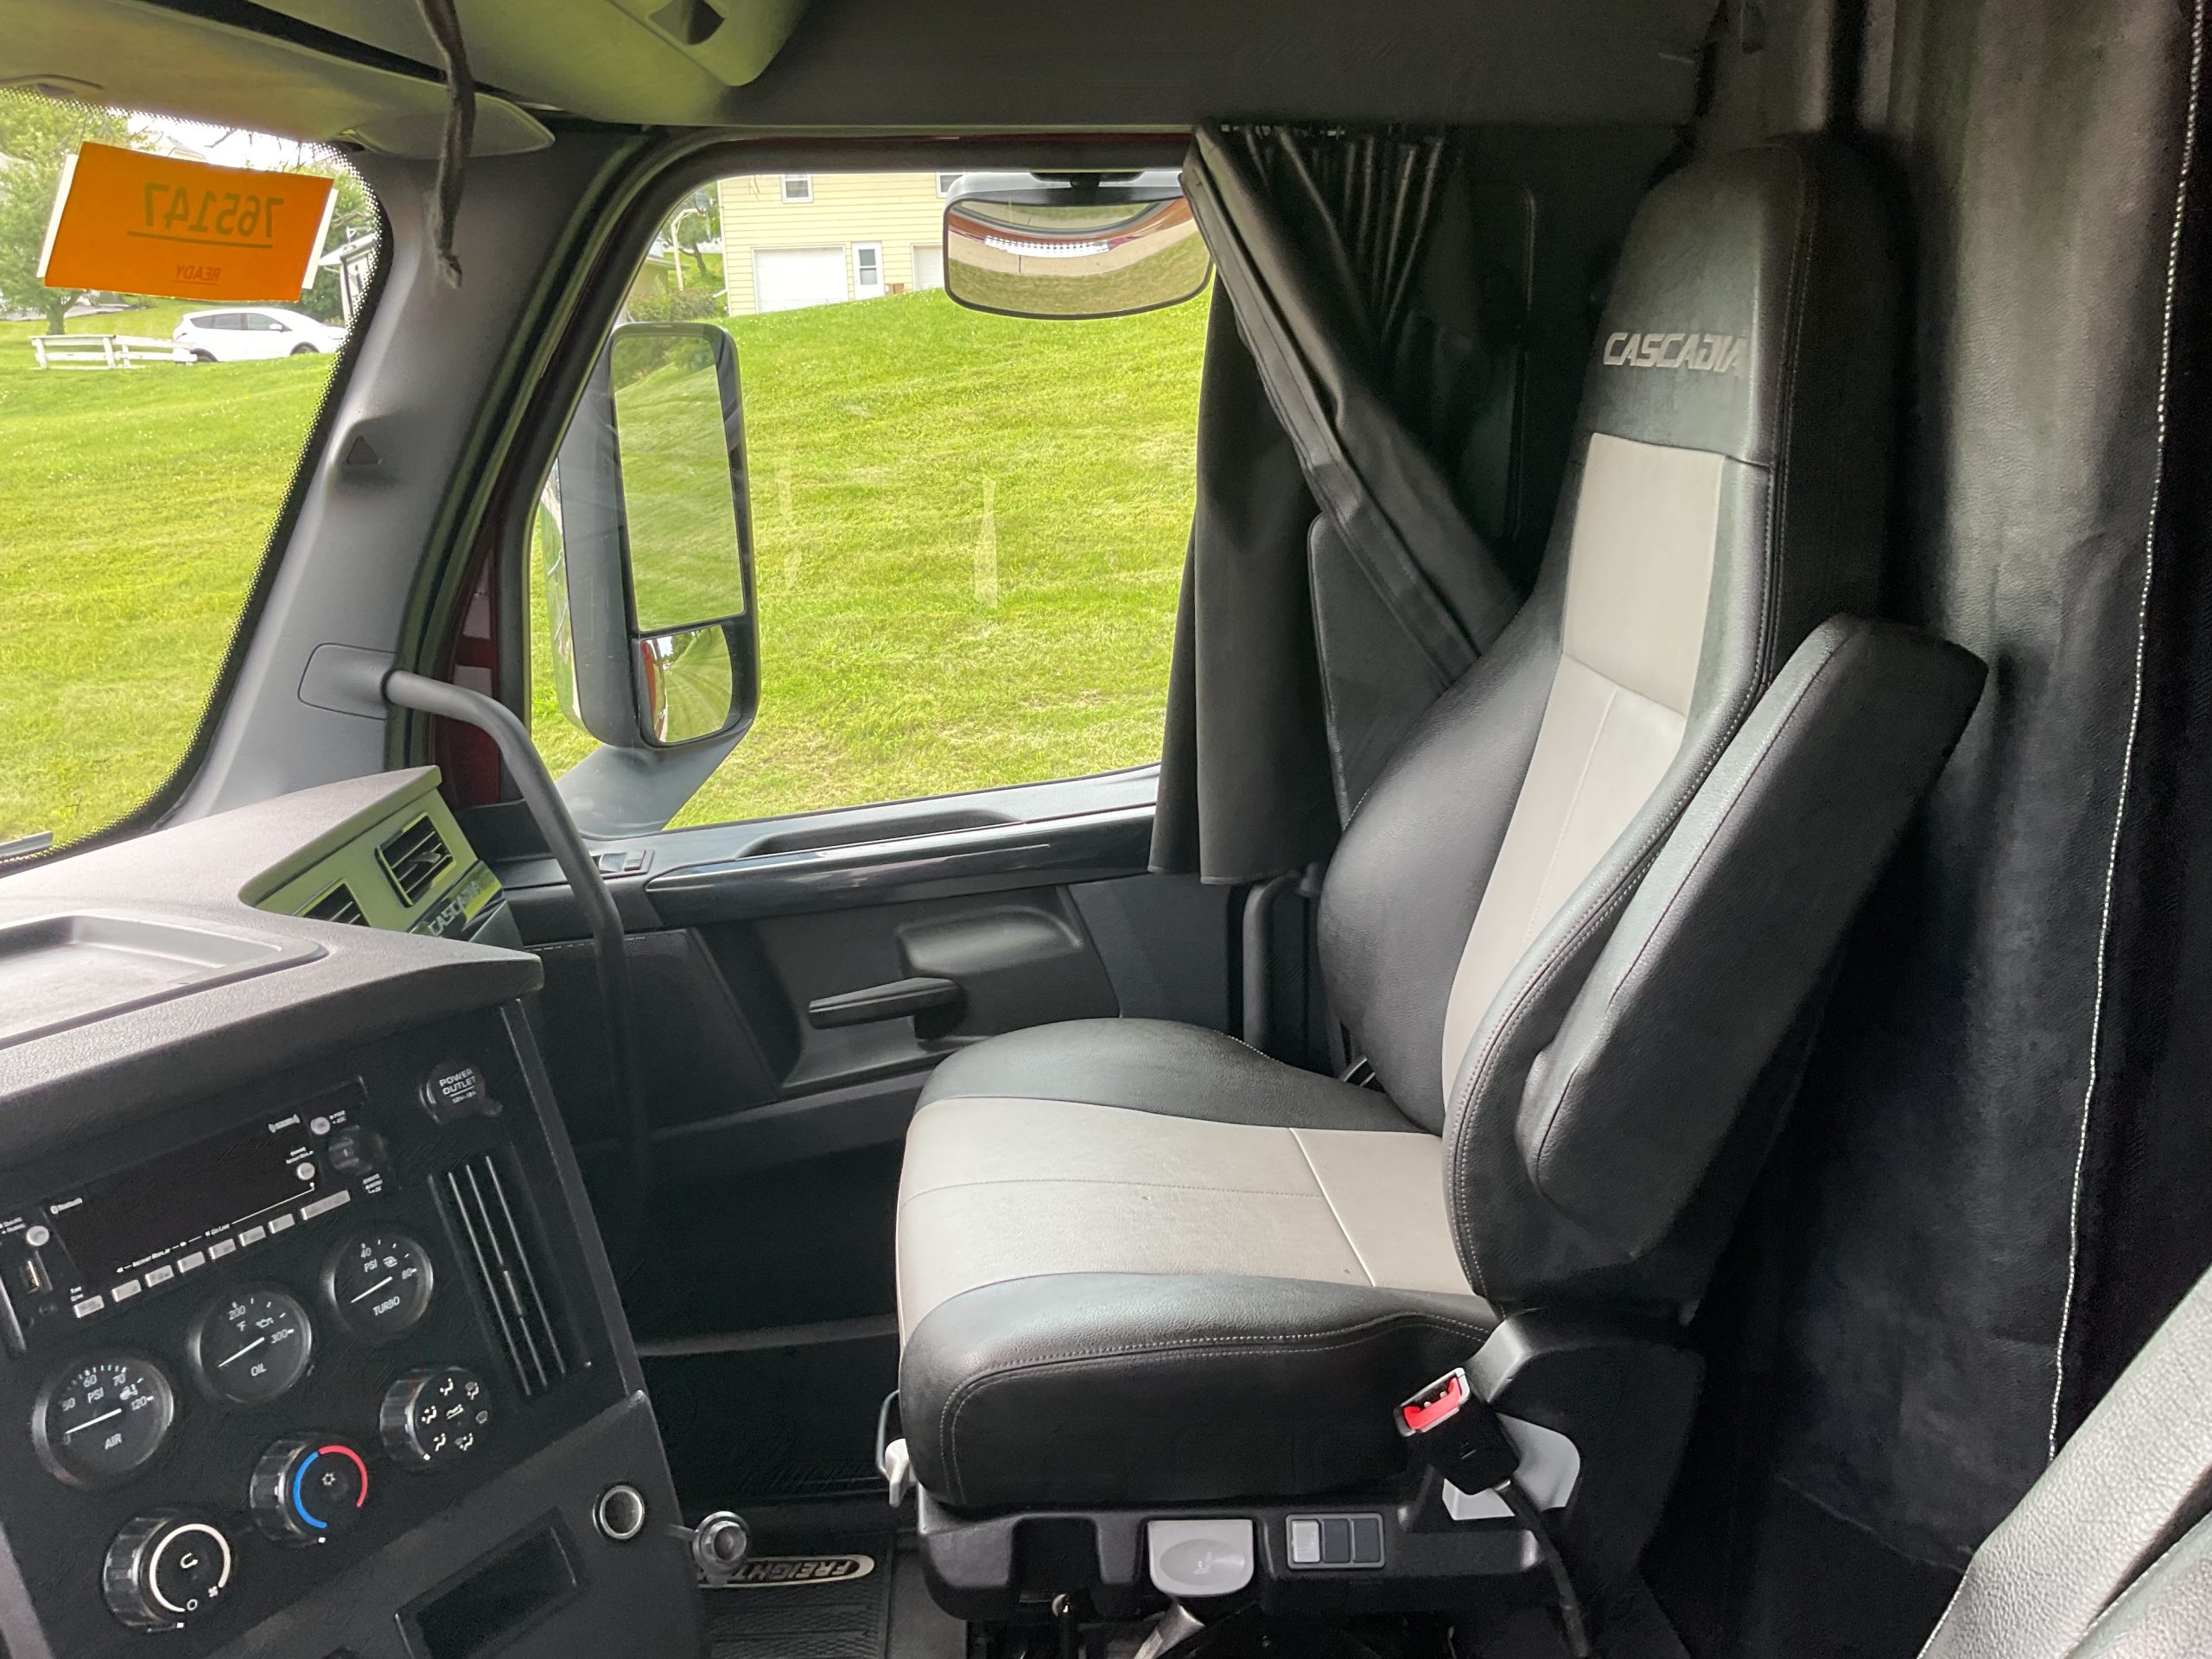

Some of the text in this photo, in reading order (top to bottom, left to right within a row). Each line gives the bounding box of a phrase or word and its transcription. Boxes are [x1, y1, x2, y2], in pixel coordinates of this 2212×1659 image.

[1603, 332, 1749, 373] CASCADIA
[439, 1068, 473, 1087] POWER
[442, 1075, 476, 1096] OUTLET
[364, 1258, 378, 1273] PSI
[228, 1305, 246, 1320] 200
[372, 1295, 400, 1316] TURBO
[270, 1328, 289, 1344] 300
[251, 1363, 267, 1376] OIL
[83, 1374, 97, 1388] 60
[112, 1373, 125, 1387] 70
[87, 1387, 104, 1403] PSI
[105, 1433, 122, 1450] AIR
[733, 1560, 854, 1580] FREIGHT
